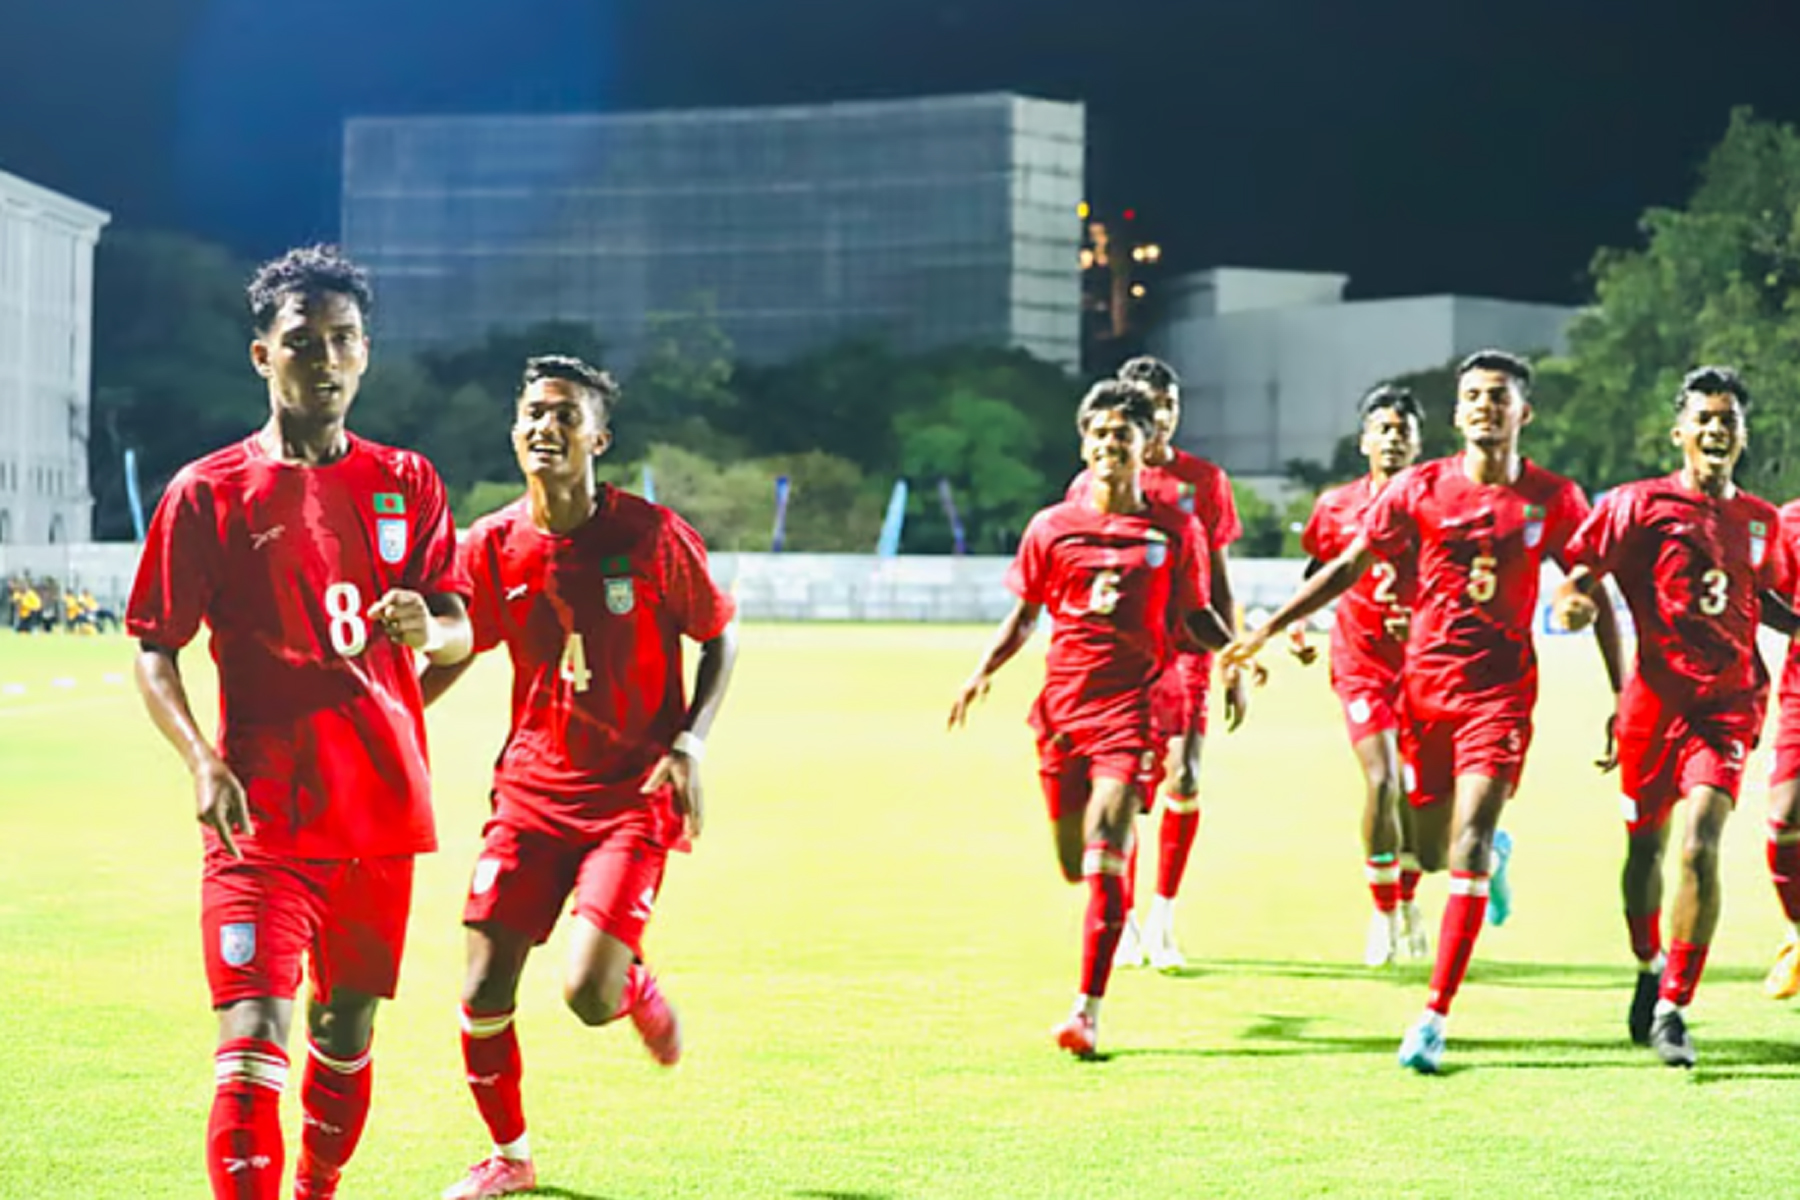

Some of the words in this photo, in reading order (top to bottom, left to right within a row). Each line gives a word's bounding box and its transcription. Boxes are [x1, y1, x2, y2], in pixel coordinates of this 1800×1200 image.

[1091, 570, 1120, 615] 6
[1372, 562, 1397, 602] 2
[1467, 556, 1497, 602] 5
[1700, 569, 1728, 615] 3
[325, 582, 367, 656] 8
[560, 632, 592, 692] 4
